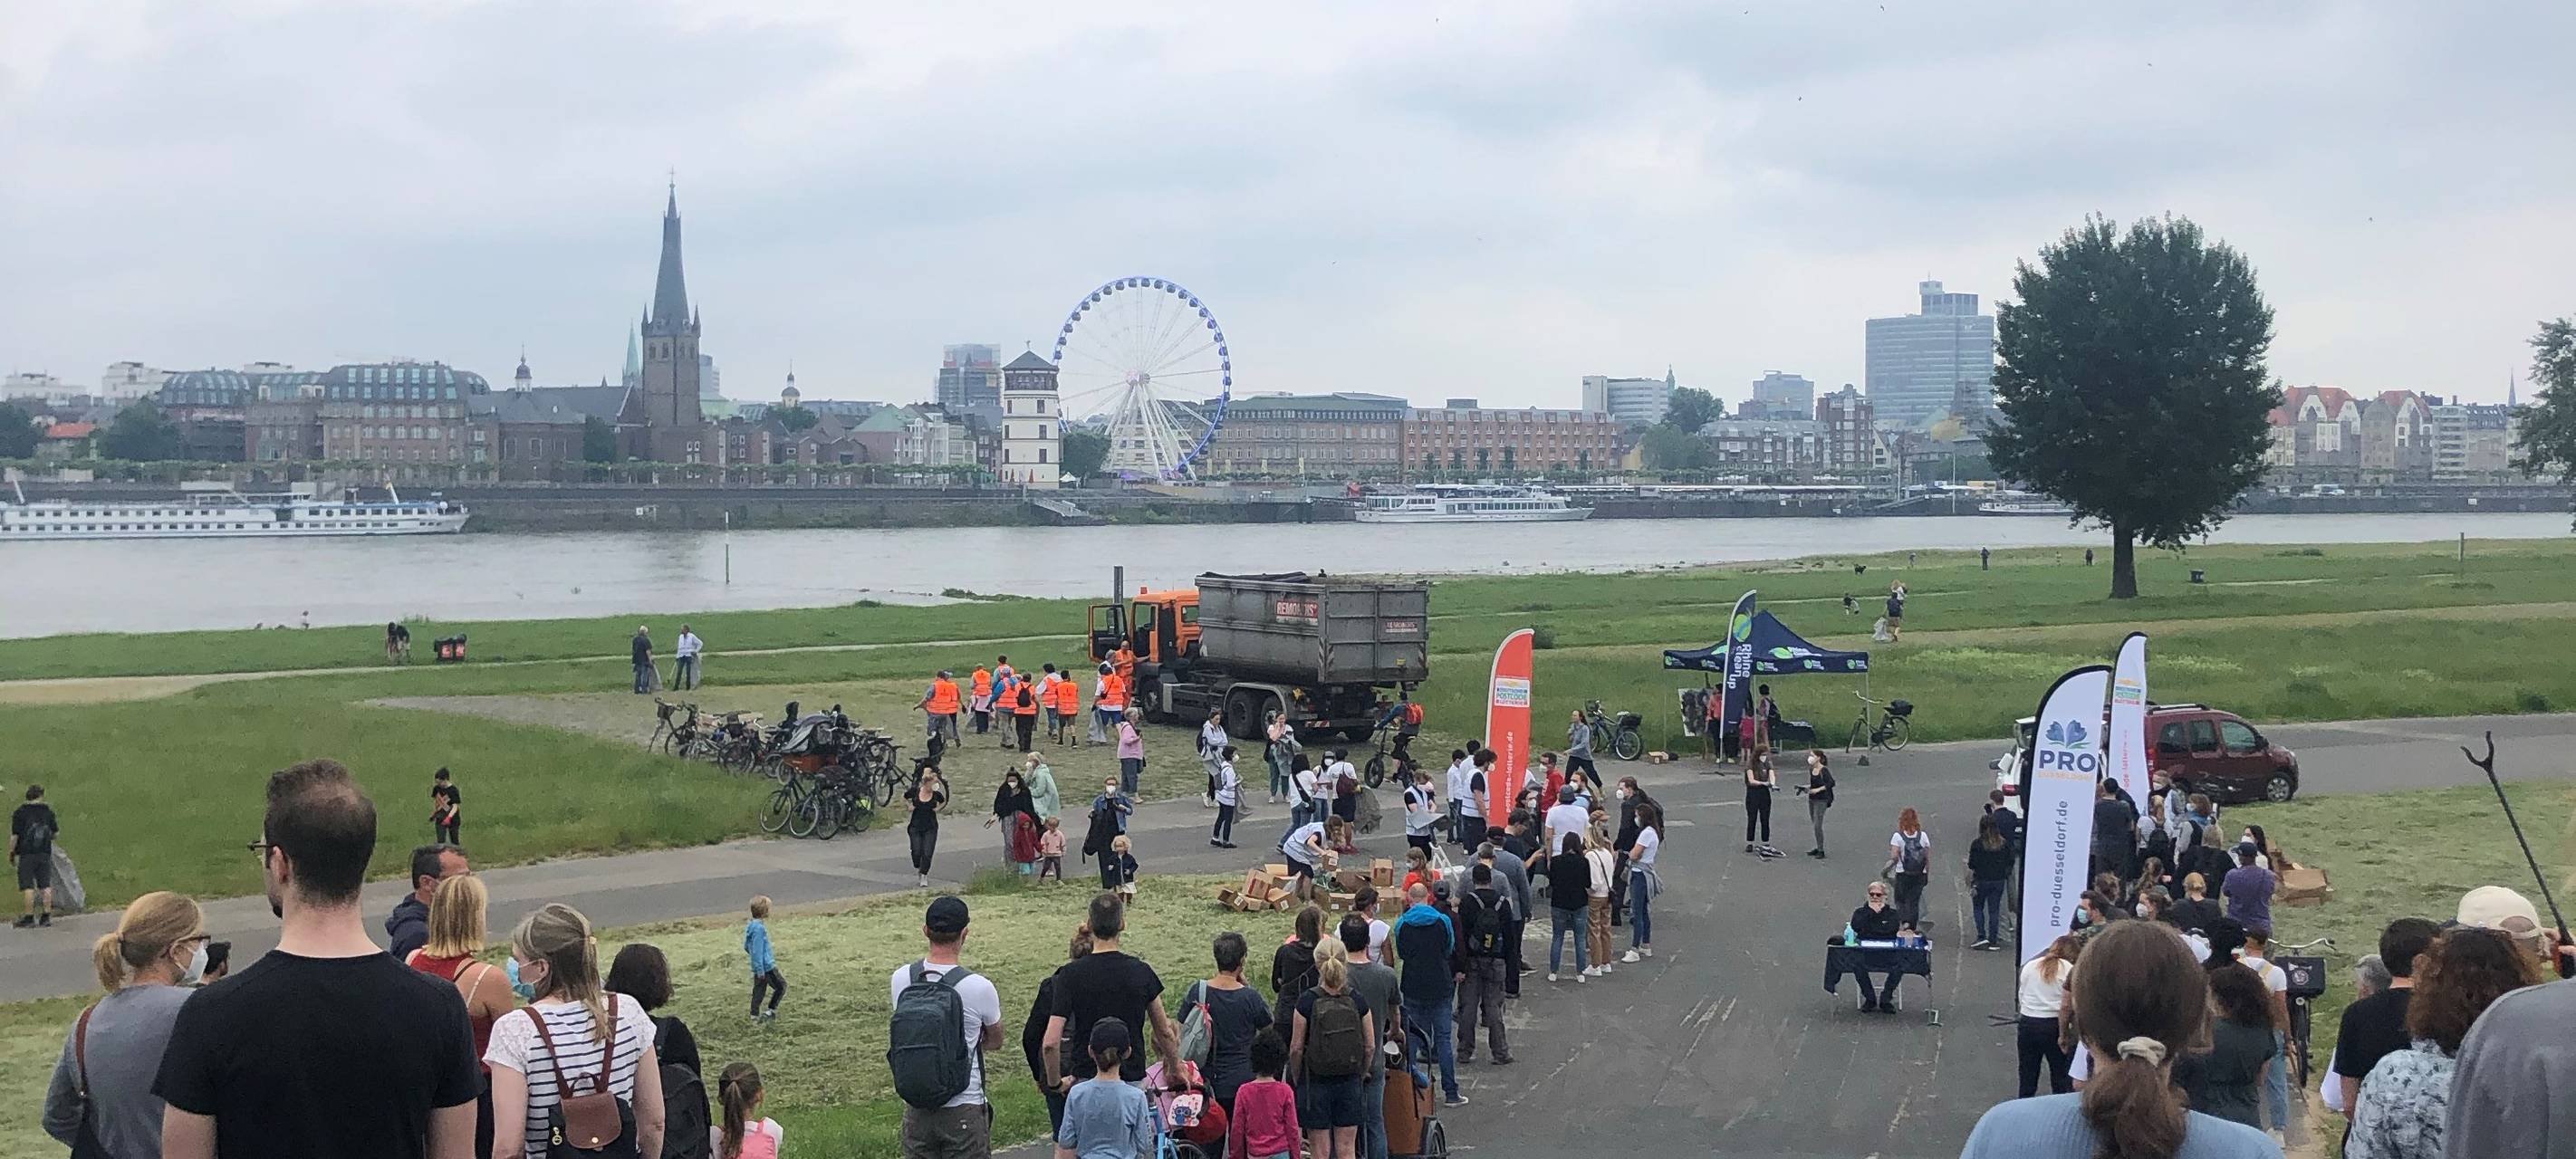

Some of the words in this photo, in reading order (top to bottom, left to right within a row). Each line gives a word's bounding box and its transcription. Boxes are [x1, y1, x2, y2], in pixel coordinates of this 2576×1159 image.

[1276, 601, 1314, 618] REMONIS
[1742, 644, 1753, 678] Rhine
[2039, 750, 2096, 772] PRO
[2051, 800, 2069, 927] pro-duesseldorf.de
